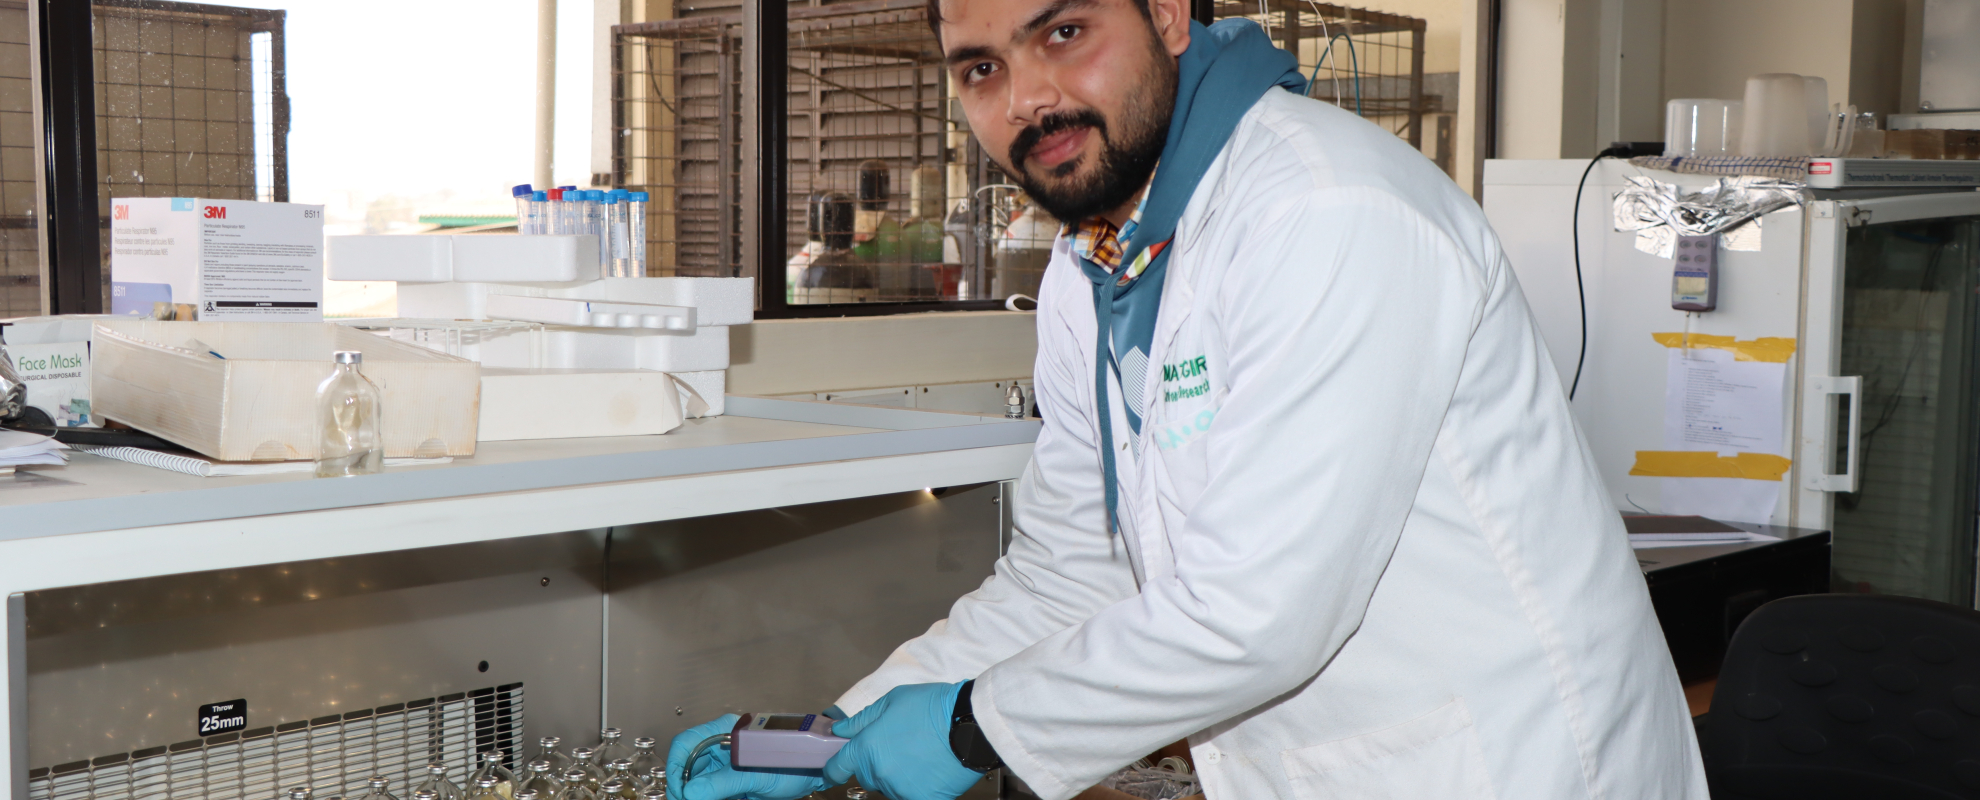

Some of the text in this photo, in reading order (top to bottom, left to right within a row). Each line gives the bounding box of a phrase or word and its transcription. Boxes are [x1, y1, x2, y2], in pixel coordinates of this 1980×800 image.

[114, 205, 129, 220] 3M
[204, 206, 226, 219] 3M
[304, 209, 320, 218] 8511
[114, 286, 126, 297] 8511
[19, 353, 82, 371] Face Mask
[212, 704, 234, 713] Throw
[201, 715, 244, 732] 25mm
